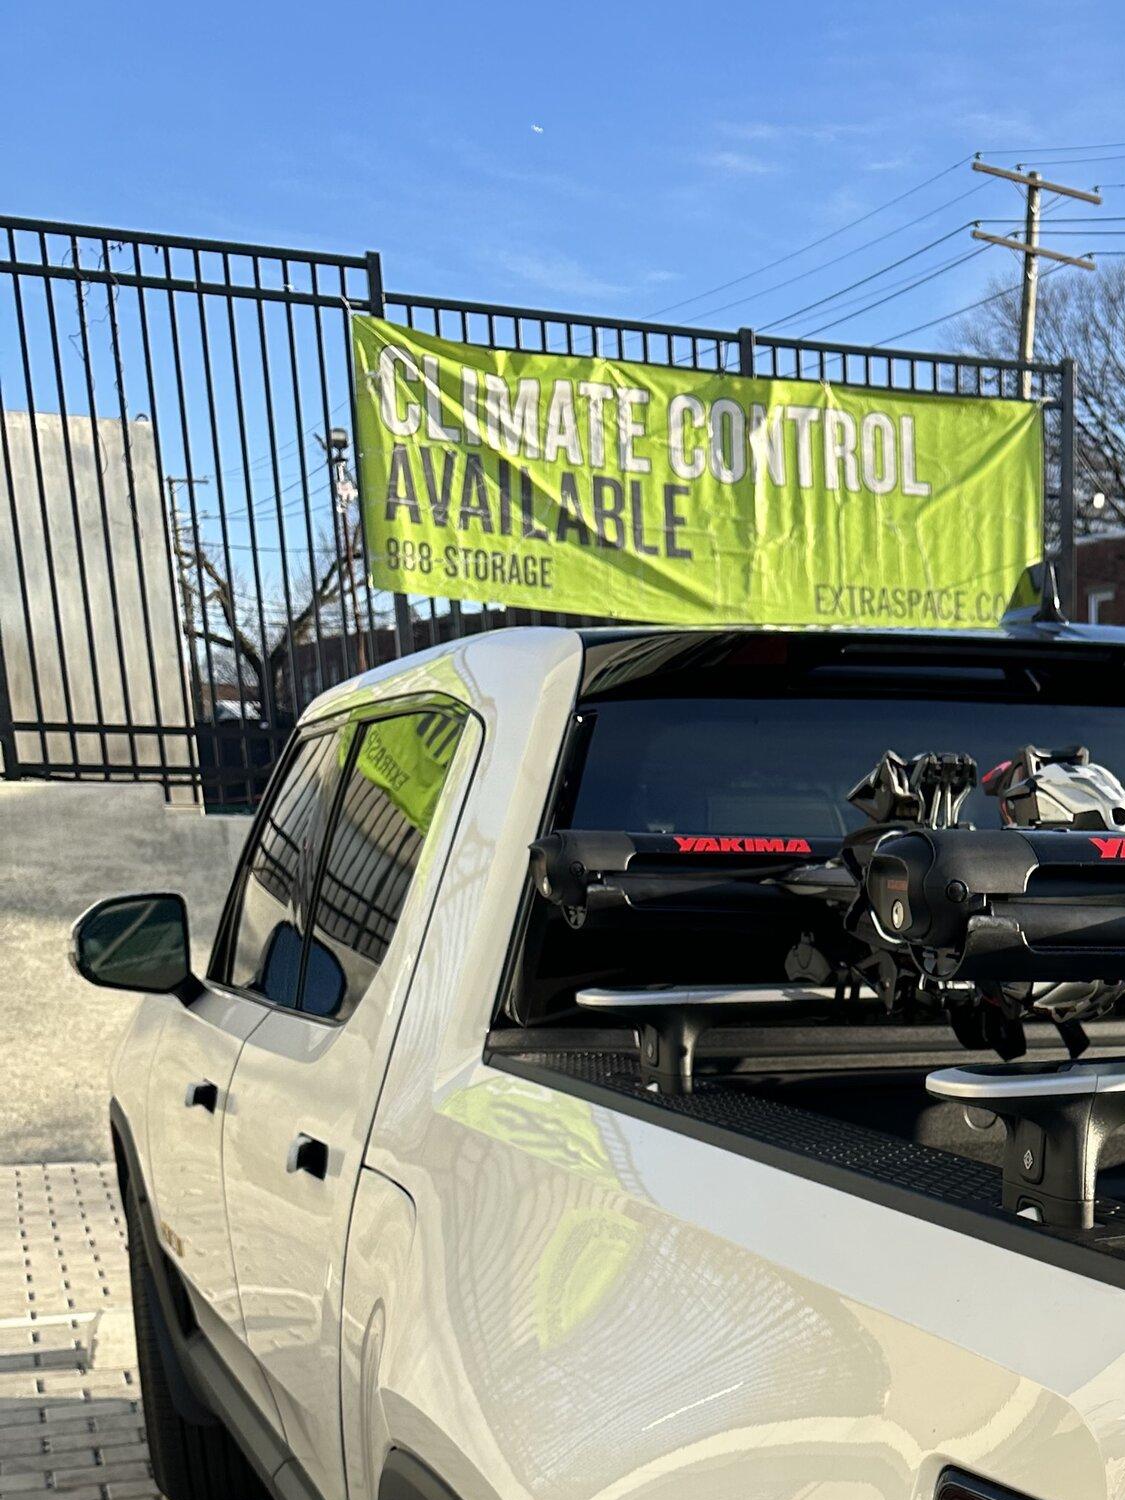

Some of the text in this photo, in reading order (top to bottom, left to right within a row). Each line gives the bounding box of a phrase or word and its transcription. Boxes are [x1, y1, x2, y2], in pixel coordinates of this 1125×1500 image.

[378, 344, 932, 498] CLIMATE CONTROL
[384, 443, 694, 560] AVAILABLE
[385, 536, 553, 588] 888-STORAGE
[673, 836, 812, 853] YAKIMA
